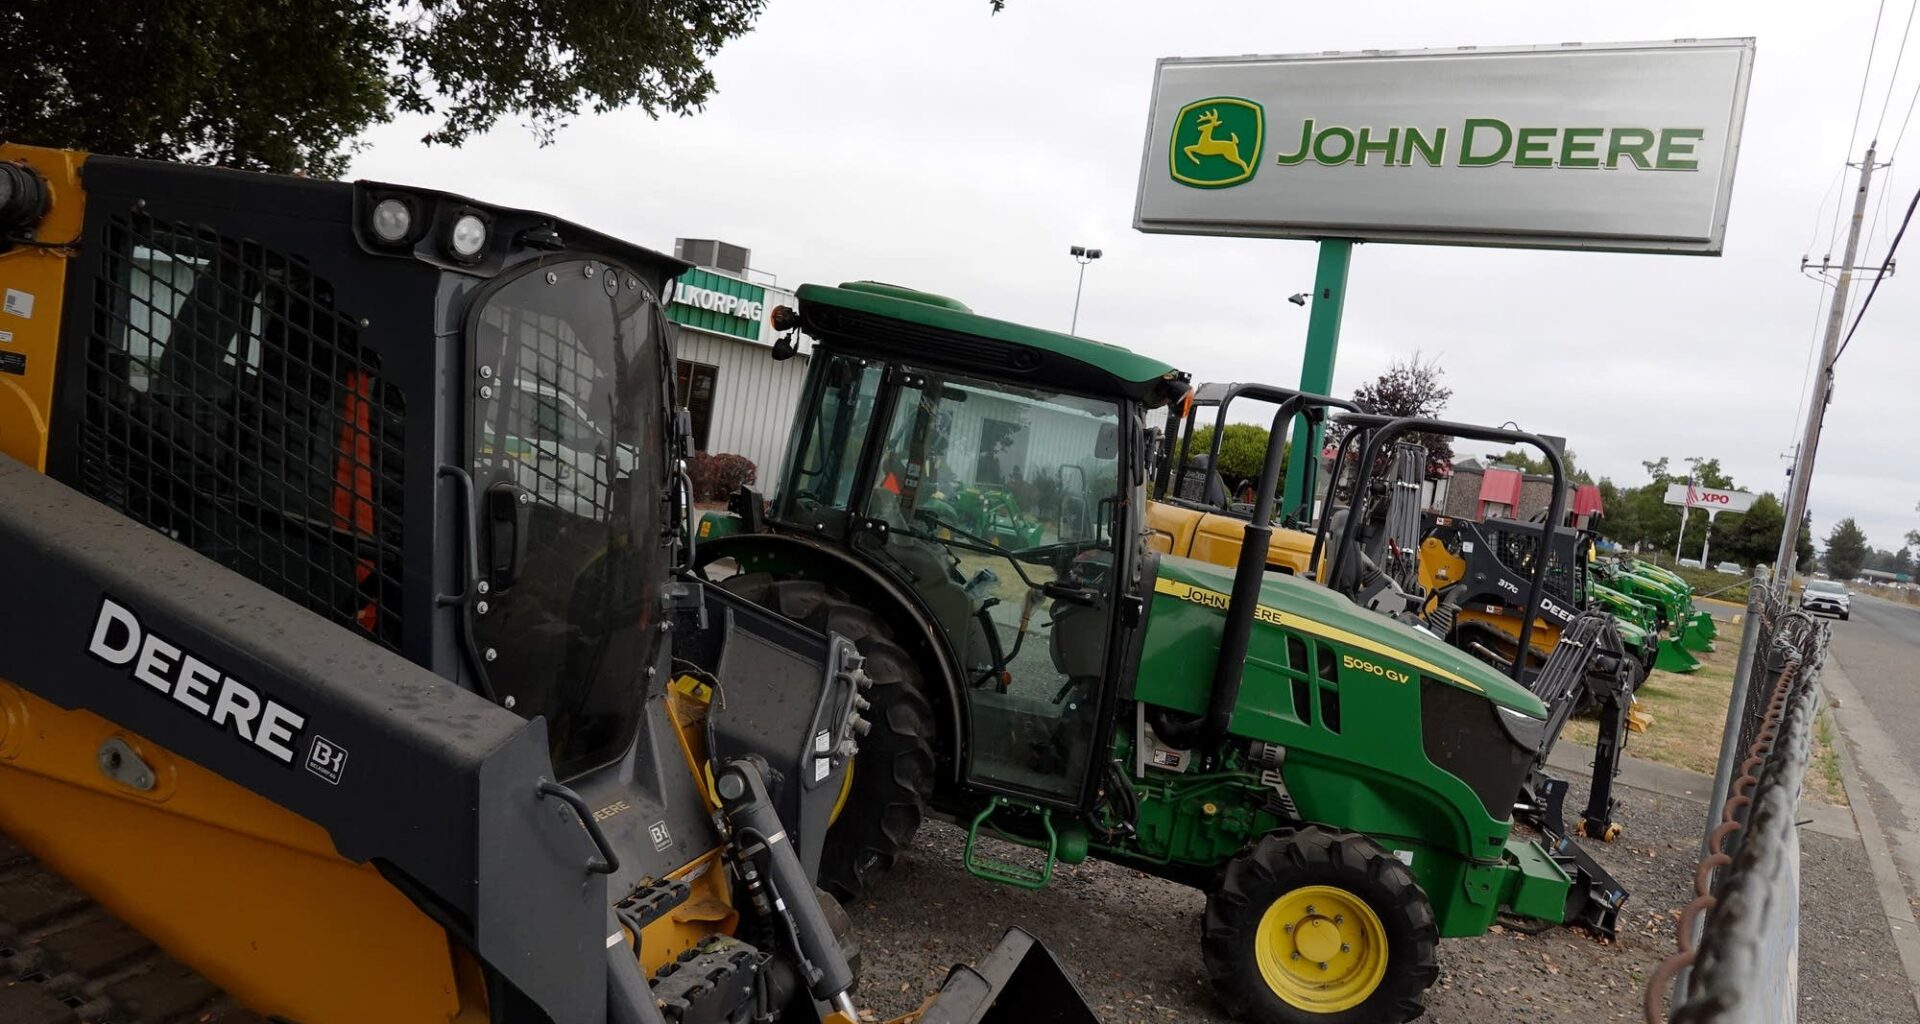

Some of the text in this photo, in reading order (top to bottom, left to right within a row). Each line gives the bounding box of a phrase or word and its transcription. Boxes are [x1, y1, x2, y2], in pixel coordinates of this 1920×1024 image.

[1276, 119, 1705, 171] JOHN DEERE
[673, 282, 737, 314] LKORP
[1701, 492, 1729, 504] XPO
[1497, 578, 1520, 594] 317G
[1182, 587, 1282, 624] JOHN ERE
[89, 598, 305, 763] DEERE
[1343, 655, 1409, 684] 5090 GV
